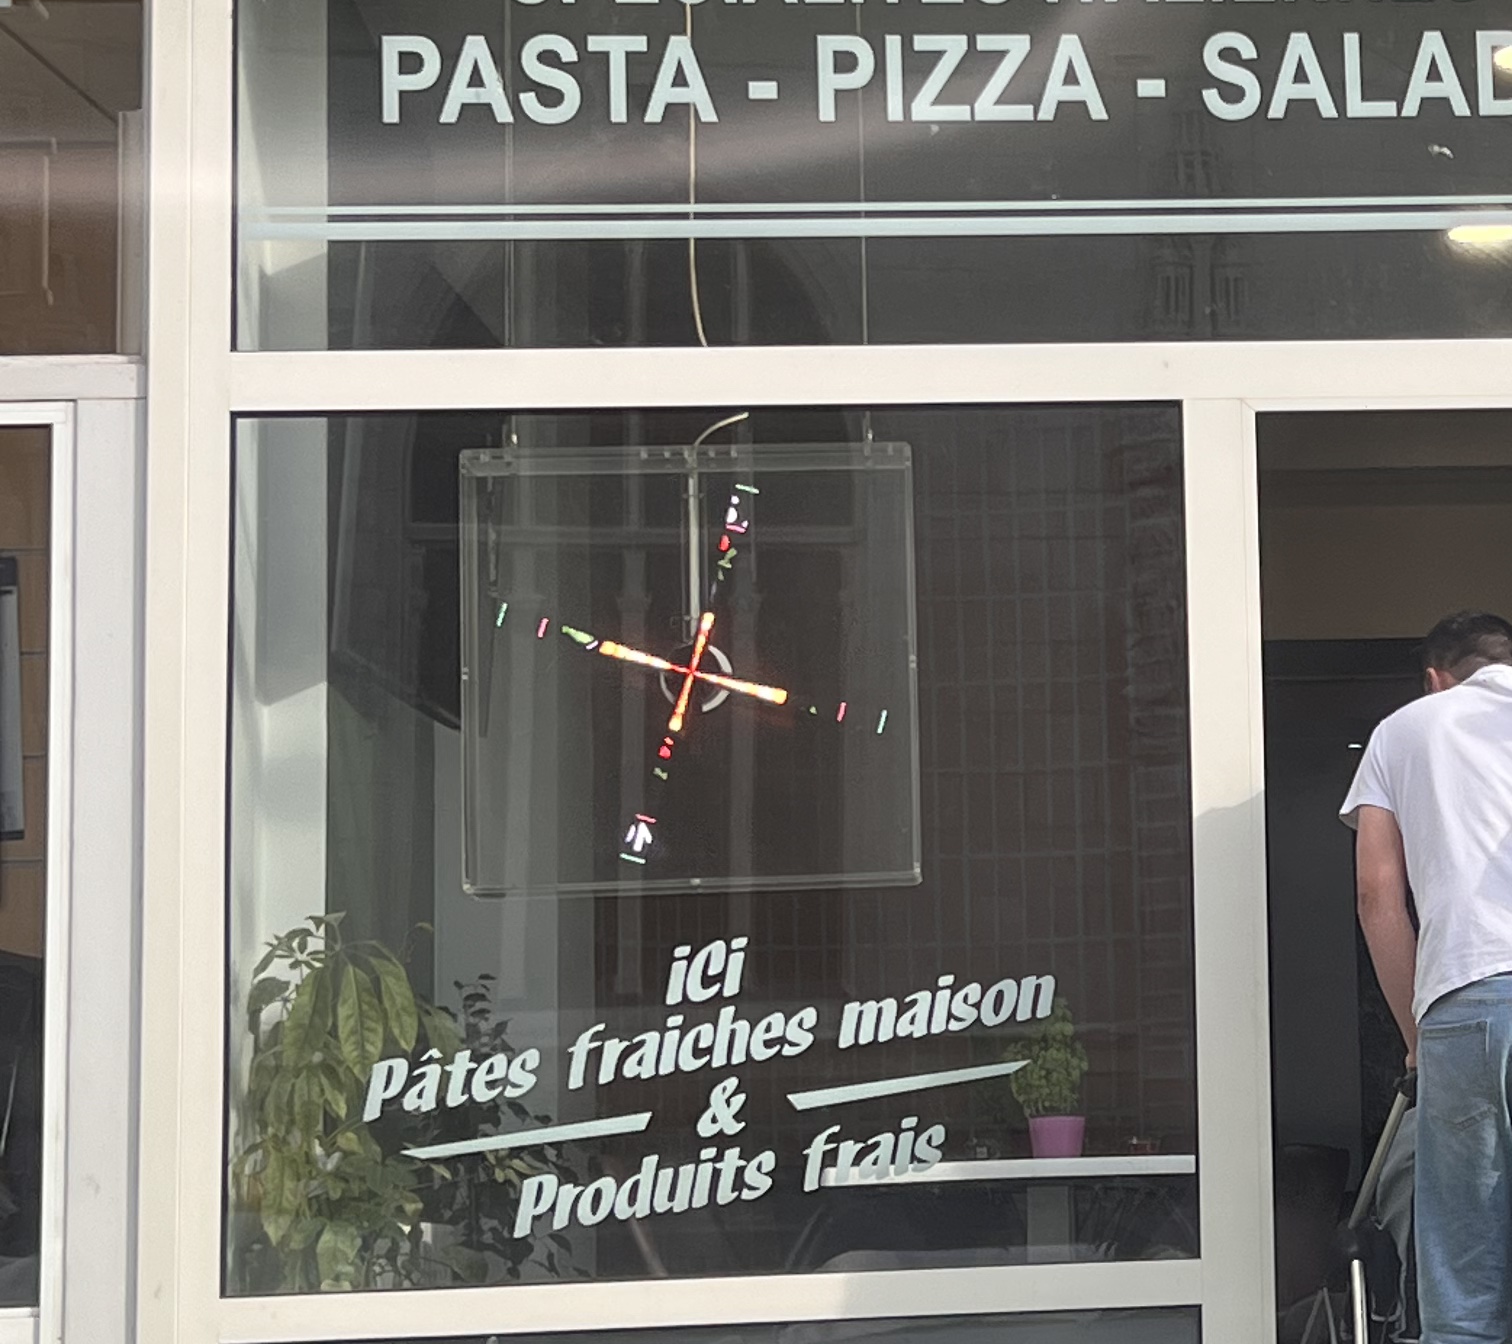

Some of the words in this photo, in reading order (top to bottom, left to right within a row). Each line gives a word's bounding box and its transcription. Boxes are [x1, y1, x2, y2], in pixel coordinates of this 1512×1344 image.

[380, 33, 719, 124] PASTA
[816, 32, 1110, 123] PIZZA
[361, 1047, 541, 1123] Pâtes
[566, 1004, 818, 1090] fraiches
[838, 973, 1057, 1050] maison
[697, 1075, 748, 1140] &
[512, 1145, 775, 1240] Produits
[802, 1114, 947, 1193] frais
